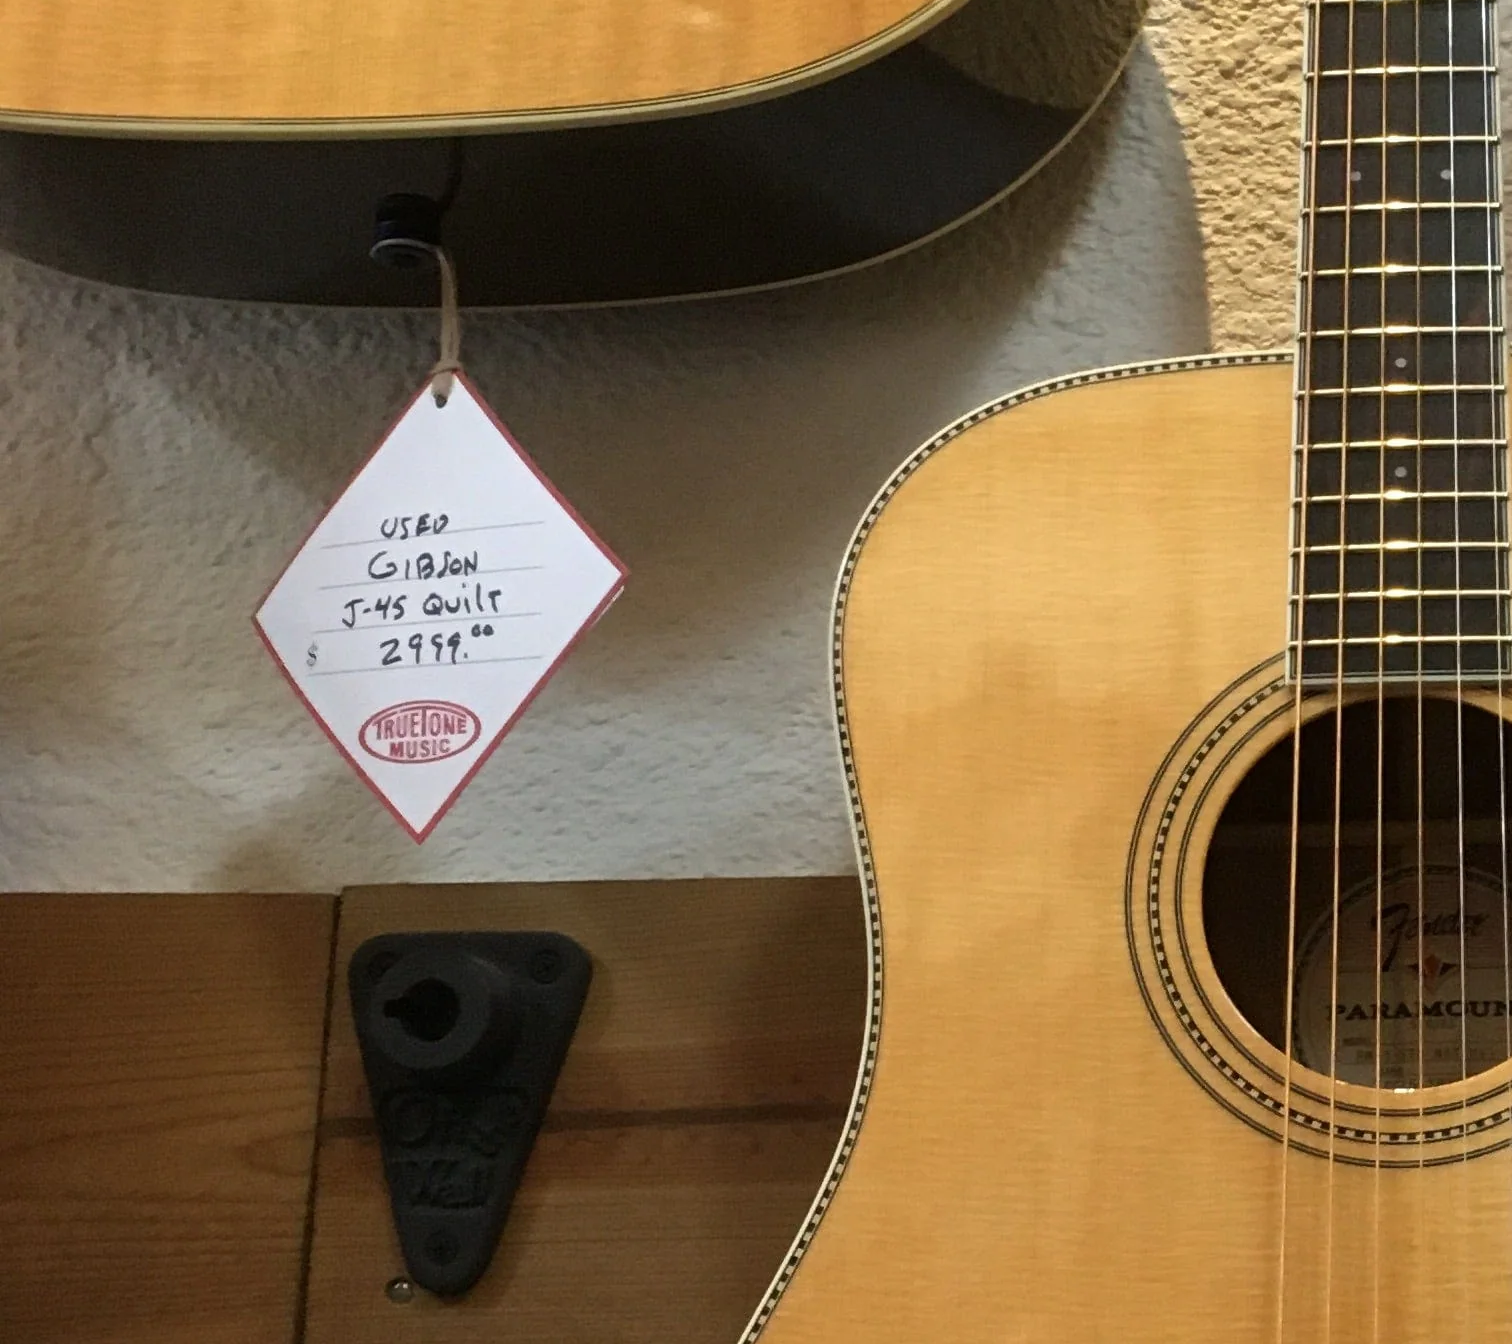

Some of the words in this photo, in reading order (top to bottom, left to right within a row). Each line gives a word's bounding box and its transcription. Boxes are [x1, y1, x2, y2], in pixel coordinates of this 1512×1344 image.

[380, 513, 449, 540] USED
[367, 550, 479, 581] GIBSON
[341, 594, 408, 629] J-45
[389, 738, 452, 758] MUSIC
